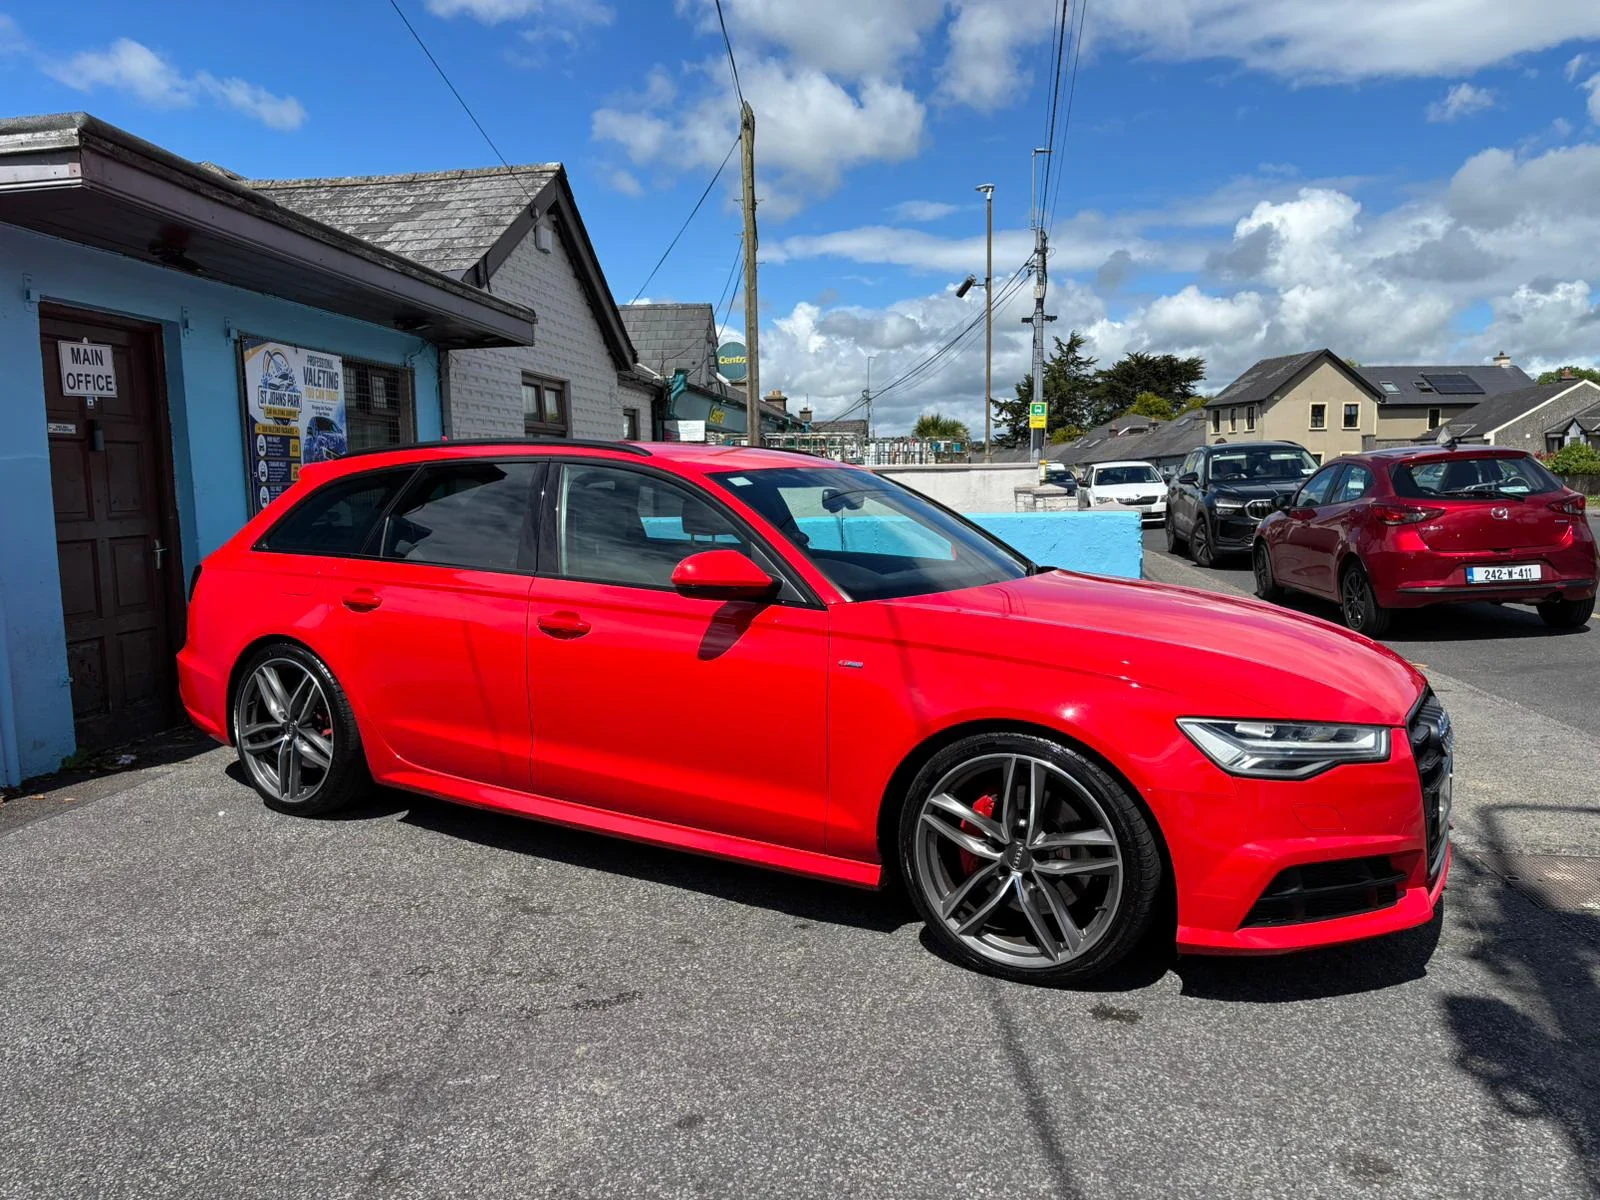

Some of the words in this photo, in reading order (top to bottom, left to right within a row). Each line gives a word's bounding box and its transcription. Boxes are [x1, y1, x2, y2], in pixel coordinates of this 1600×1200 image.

[71, 347, 104, 366] MAIN
[306, 355, 334, 369] PROFESSIONAL
[66, 372, 114, 392] OFFICE
[303, 367, 339, 390] VALETING
[260, 390, 267, 404] ST
[268, 391, 287, 406] JOHNS
[287, 393, 301, 408] PARK
[1484, 568, 1532, 580] 242-W-411
